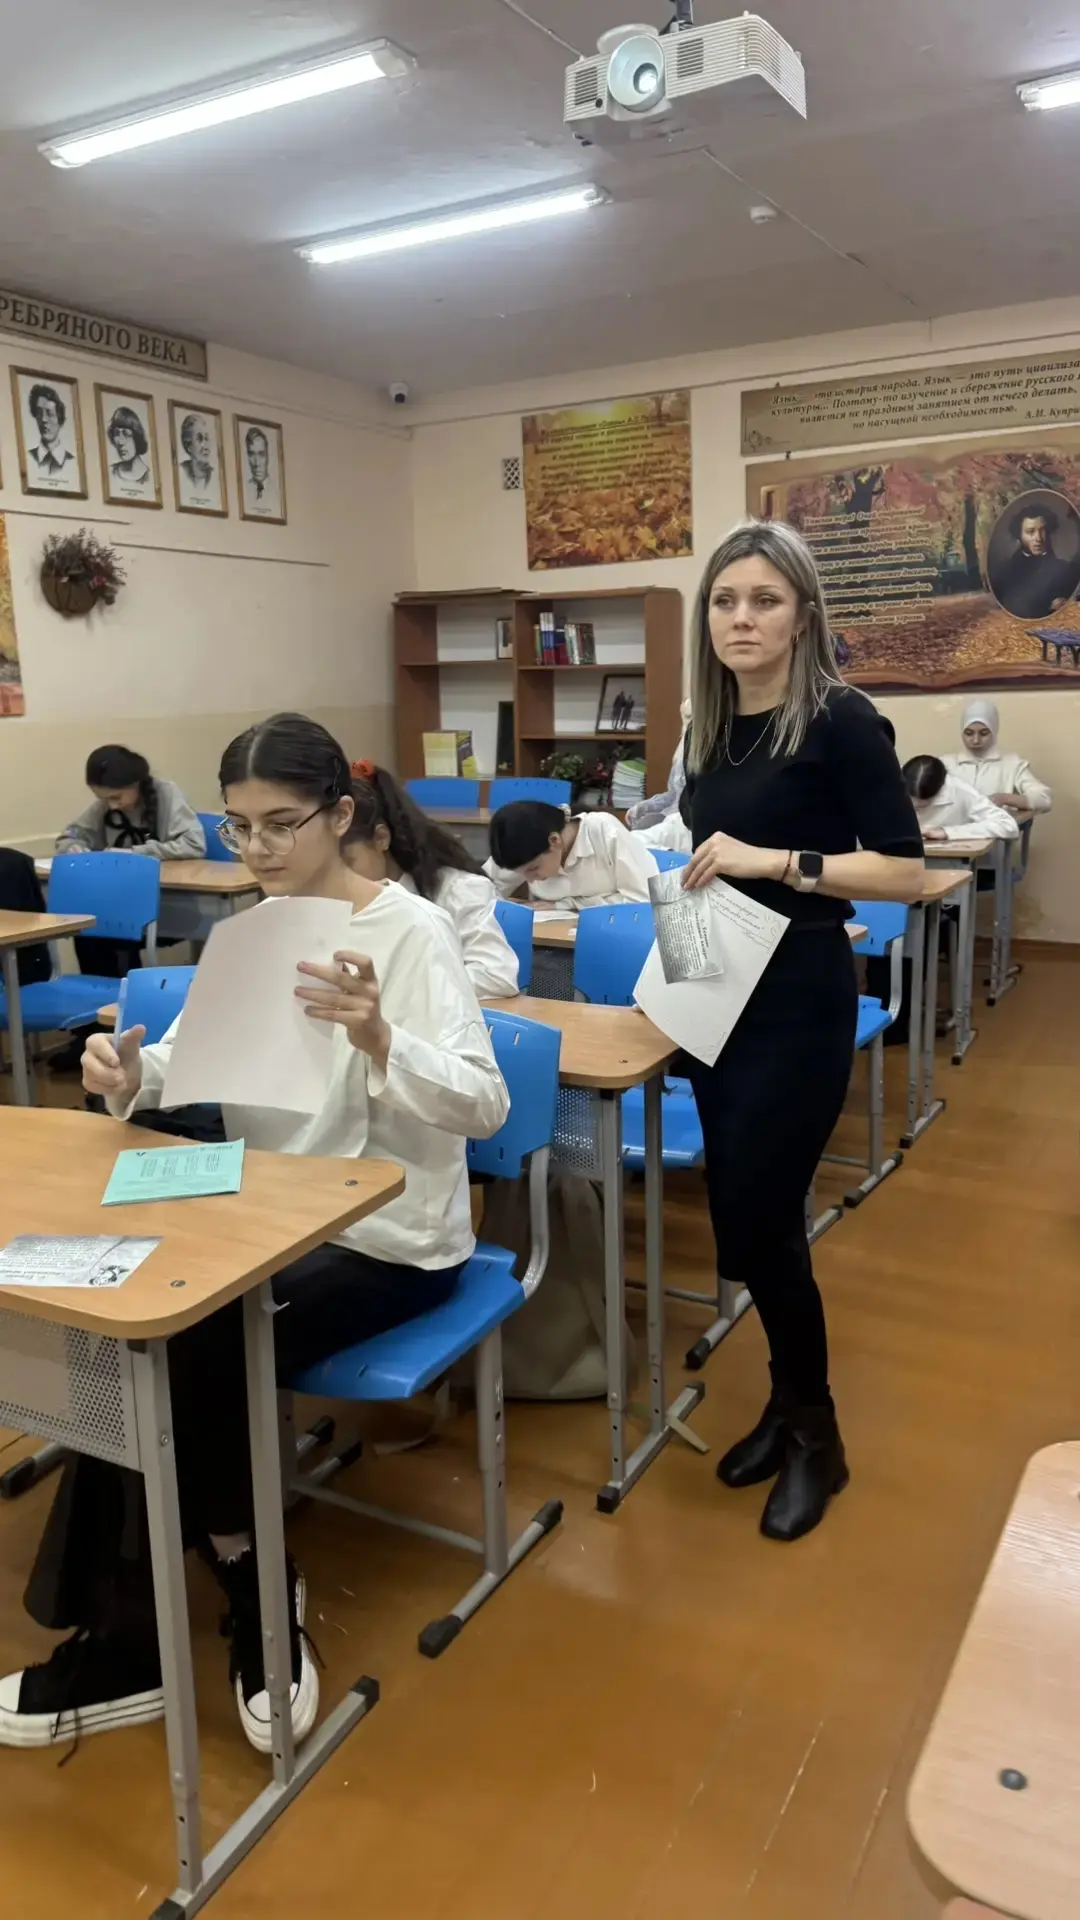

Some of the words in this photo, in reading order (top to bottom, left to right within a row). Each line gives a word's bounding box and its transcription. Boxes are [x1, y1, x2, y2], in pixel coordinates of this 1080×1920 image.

[137, 333, 188, 366] ВЕКА
[832, 395, 898, 409] Поэтому-то
[901, 387, 948, 401] изучение
[960, 380, 1023, 395] сбережение
[1025, 374, 1075, 389] русского
[834, 385, 878, 396] история
[881, 378, 920, 391] народа.
[924, 375, 951, 385] Язык
[969, 371, 990, 380] это
[993, 368, 1023, 379] путь
[849, 410, 860, 418] не
[862, 403, 914, 418] праздным
[916, 398, 971, 411] занятием
[973, 395, 990, 404] от
[992, 390, 1028, 402] нечего
[1031, 385, 1078, 398] делать,
[852, 421, 865, 429] но
[867, 415, 918, 430] насущной
[921, 404, 1017, 421] необходимостью.
